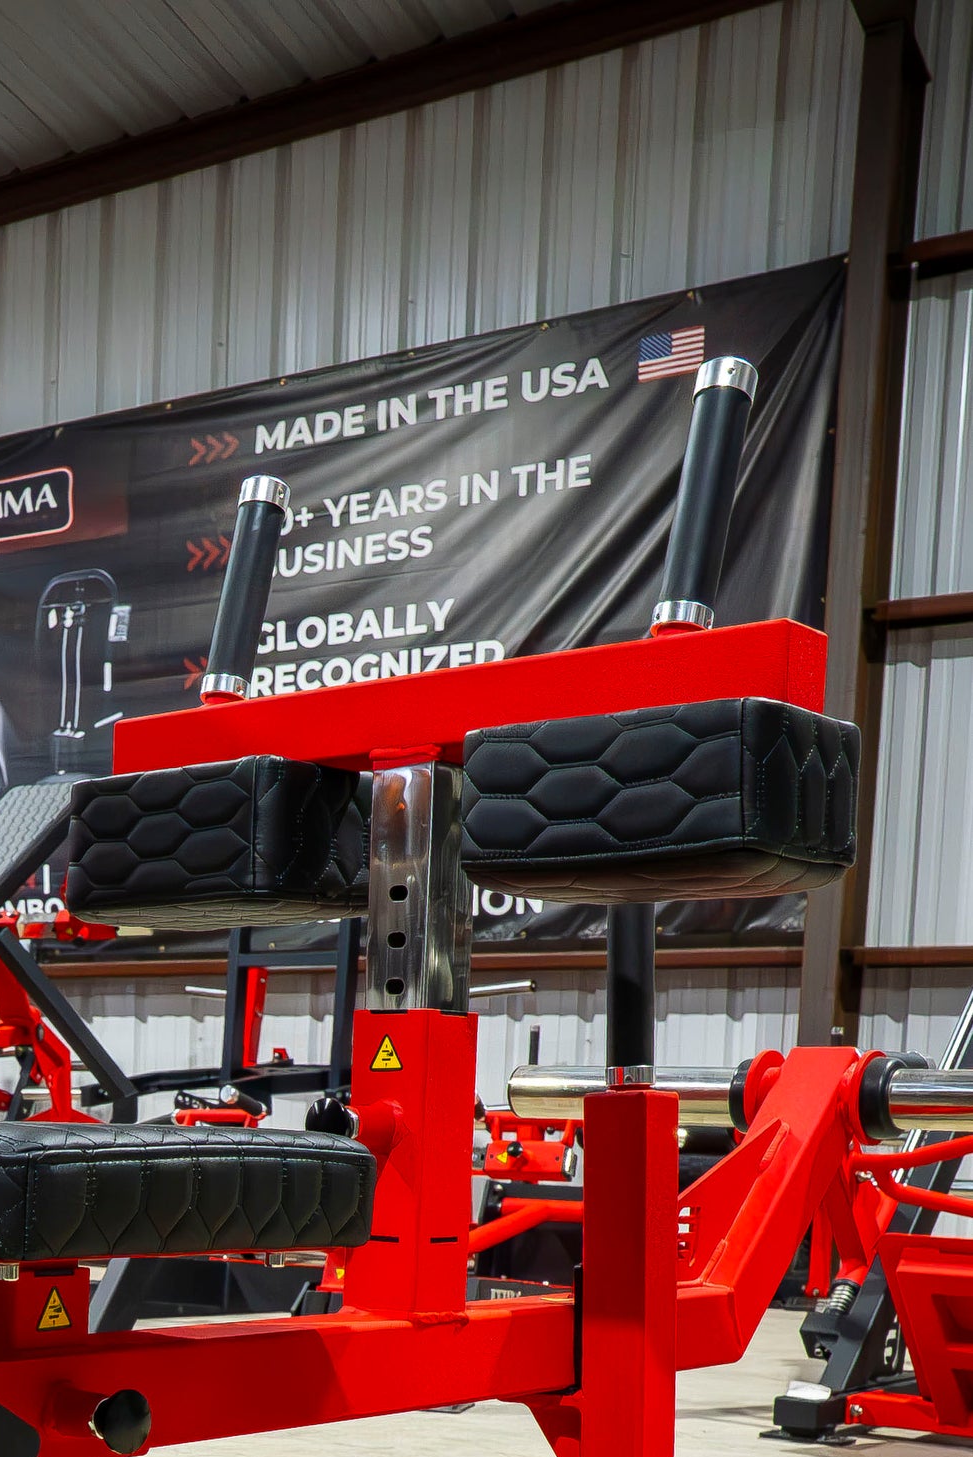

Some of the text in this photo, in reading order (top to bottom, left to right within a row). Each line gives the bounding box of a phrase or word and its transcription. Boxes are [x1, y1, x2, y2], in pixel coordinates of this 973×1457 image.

[254, 357, 610, 454] MADE IN THE USA
[323, 479, 447, 528] YEARS
[459, 470, 499, 507] IN
[511, 454, 592, 497] THE
[273, 525, 434, 578] USINESS
[257, 598, 455, 655] GLOBALLY
